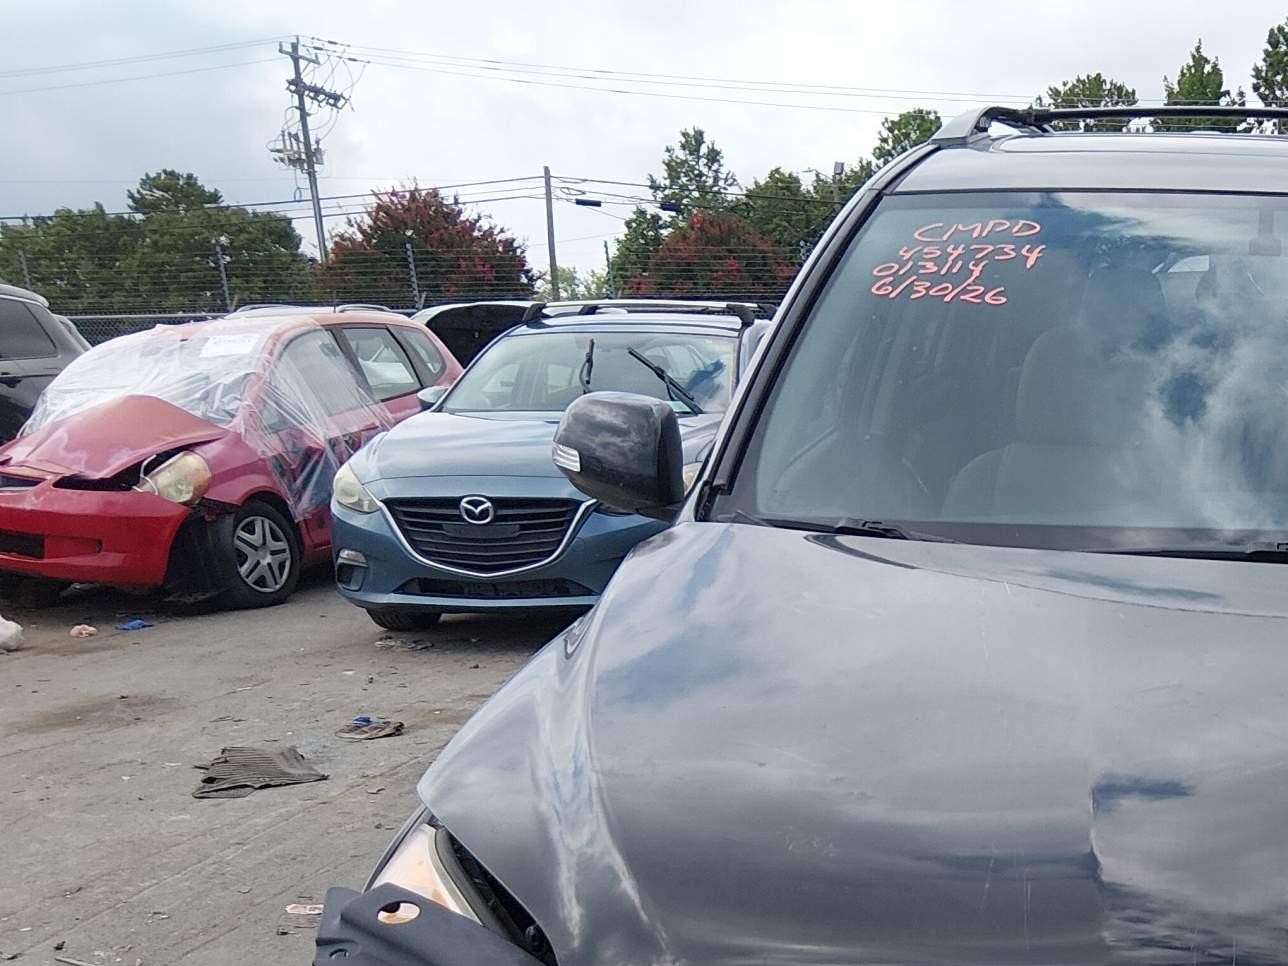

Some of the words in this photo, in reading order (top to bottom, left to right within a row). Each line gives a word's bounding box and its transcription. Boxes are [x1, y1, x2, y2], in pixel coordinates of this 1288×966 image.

[913, 219, 1042, 242] CMPD
[898, 243, 1047, 270] 454734
[871, 275, 1008, 305] 6/30/26
